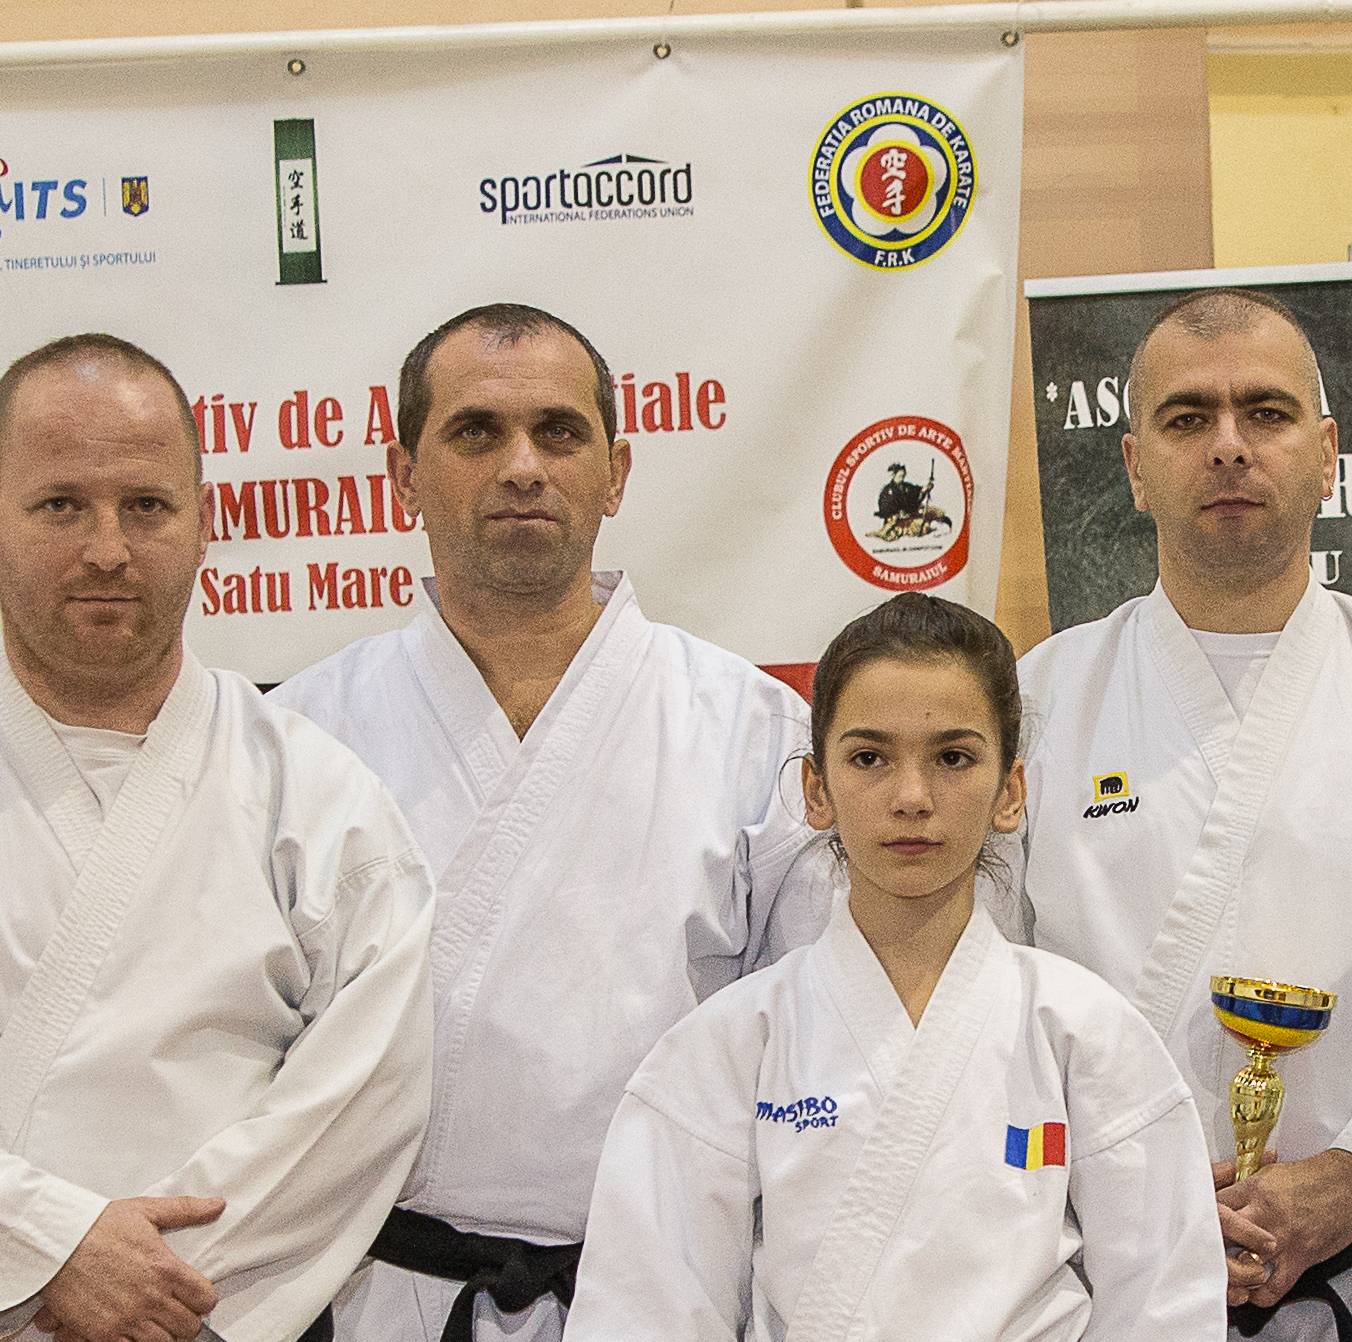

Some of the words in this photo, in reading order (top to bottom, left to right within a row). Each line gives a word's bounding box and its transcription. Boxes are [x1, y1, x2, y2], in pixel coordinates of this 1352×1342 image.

[815, 121, 853, 218] FEDERATIA
[849, 98, 932, 126] ROMANA
[931, 113, 956, 137] DE
[948, 135, 973, 209] KARATE
[479, 162, 693, 225] sportaccord
[506, 209, 587, 225] INTERNATIONAL
[588, 207, 658, 221] FEDERATIONS
[660, 206, 695, 219] UNION
[4, 254, 78, 271] TINERETULUI
[92, 251, 157, 266] SPORTULUI
[278, 390, 345, 451] de
[845, 426, 895, 466] SPORTIV
[897, 424, 917, 437] DE
[918, 426, 954, 450] ARTE
[871, 561, 948, 586] SAMURAIUL
[200, 565, 293, 617] Satu
[307, 562, 415, 612] Mare
[1083, 796, 1140, 819] KWON
[755, 1095, 838, 1123] MASIBO
[795, 1115, 839, 1134] SPORT
